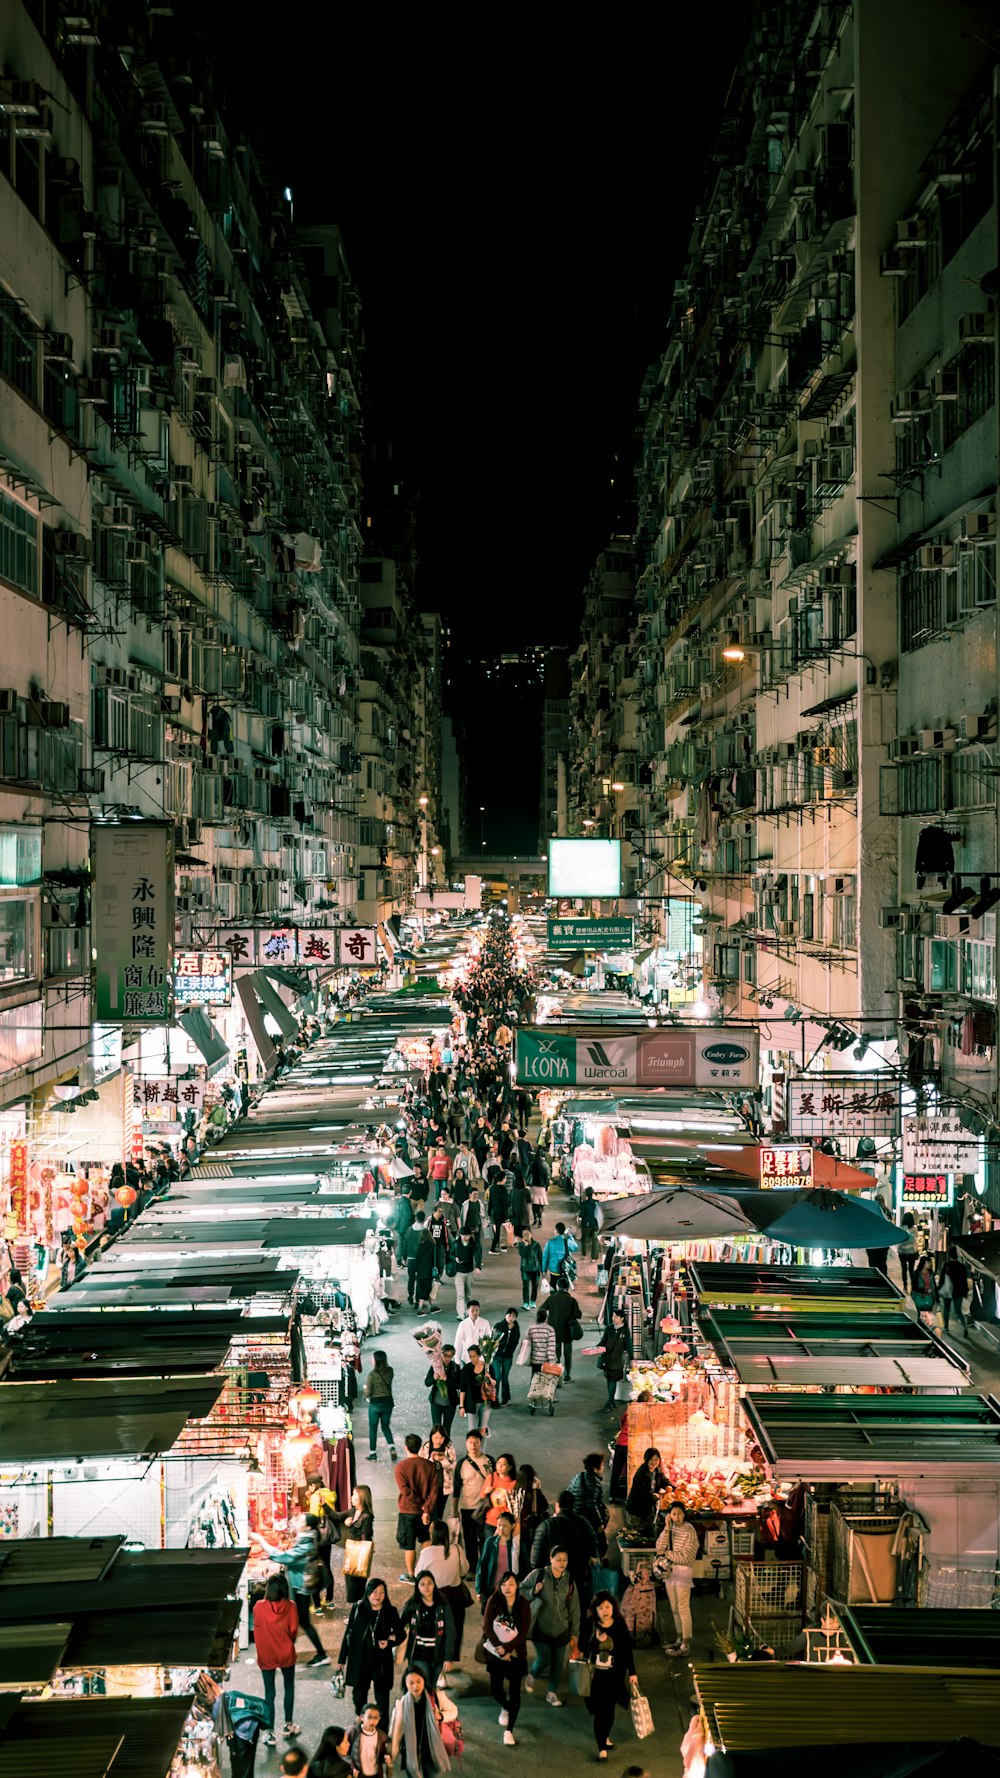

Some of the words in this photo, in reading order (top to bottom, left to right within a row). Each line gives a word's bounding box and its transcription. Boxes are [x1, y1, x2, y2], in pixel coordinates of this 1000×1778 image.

[131, 877, 156, 959] 永興隆
[706, 1050, 726, 1060] Embry
[729, 1051, 746, 1060] Form
[648, 1056, 685, 1069] Triumph
[584, 1067, 628, 1078] Wacoal
[709, 1069, 741, 1078] 安莉芳
[763, 1175, 812, 1187] 60980978
[903, 1193, 947, 1201] 60980978
